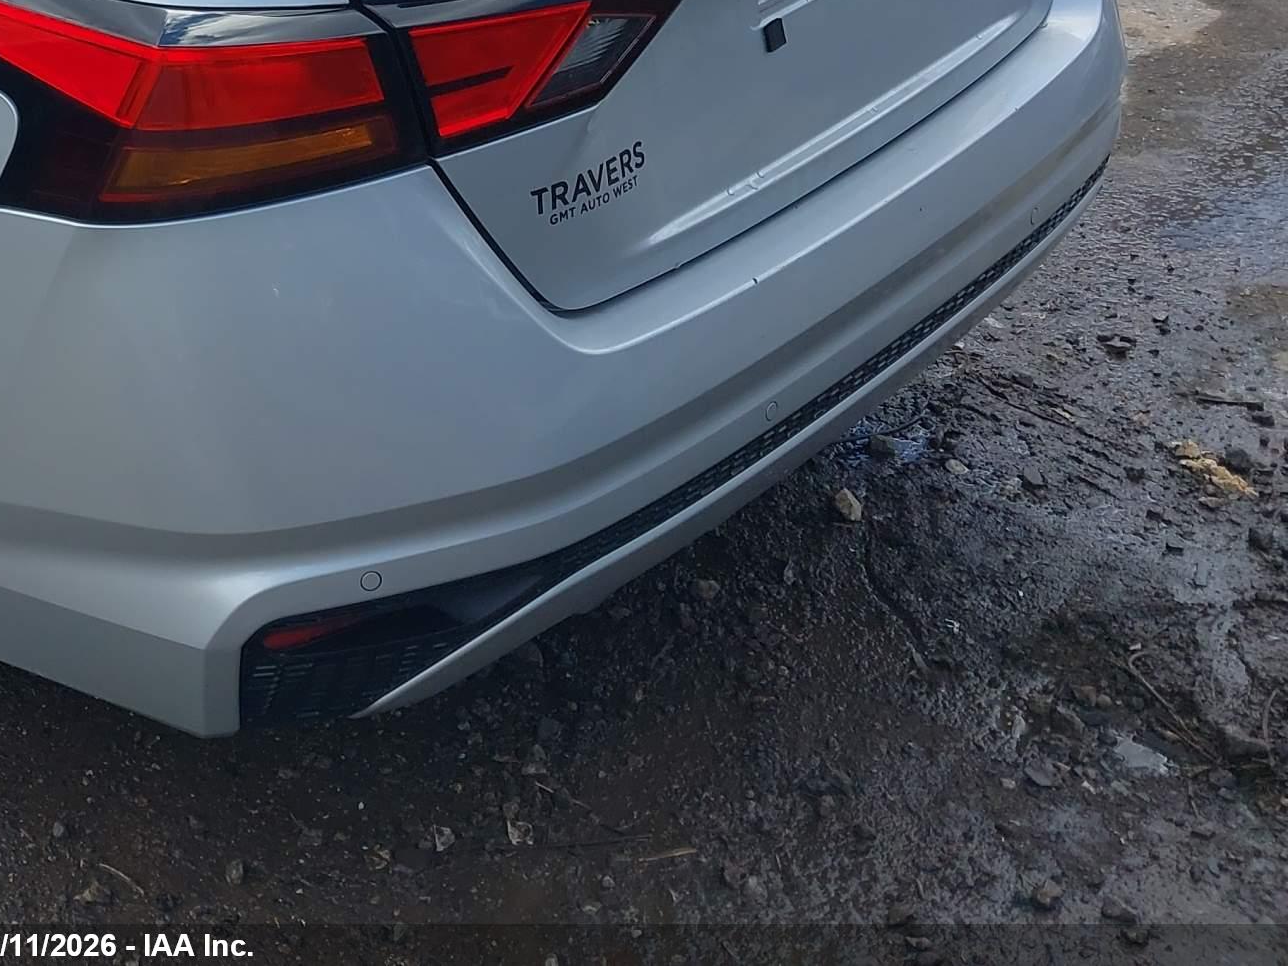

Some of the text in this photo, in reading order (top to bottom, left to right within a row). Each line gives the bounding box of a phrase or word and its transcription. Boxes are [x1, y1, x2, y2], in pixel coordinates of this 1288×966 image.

[530, 140, 646, 215] TRAVERS
[549, 175, 638, 225] GMT AUTO WEST
